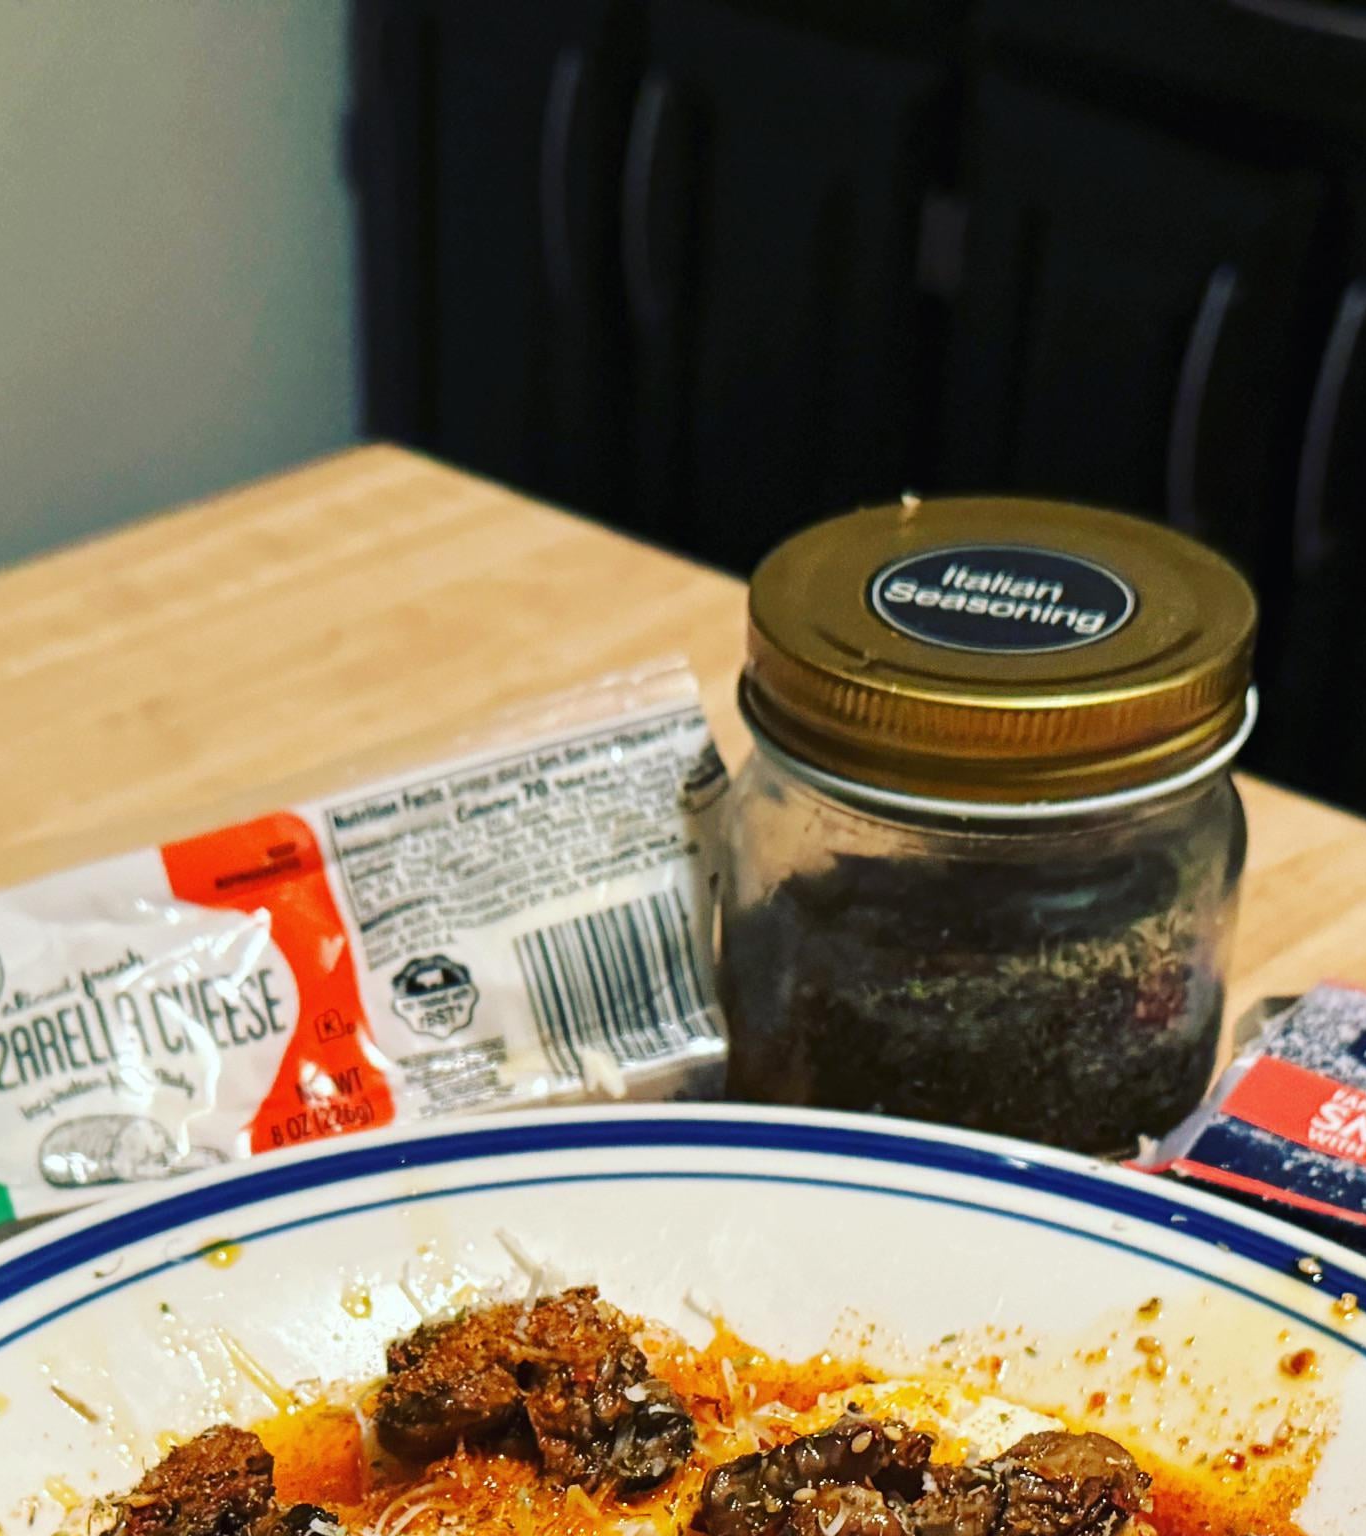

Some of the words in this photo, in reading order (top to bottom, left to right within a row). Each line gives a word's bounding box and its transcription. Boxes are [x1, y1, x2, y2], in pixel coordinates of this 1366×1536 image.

[941, 562, 1064, 602] Italian
[884, 578, 1108, 635] Seasoning
[329, 1065, 363, 1097] WT
[271, 1125, 285, 1147] 8
[286, 1112, 311, 1140] OZ
[1307, 1127, 1366, 1159] WITH
